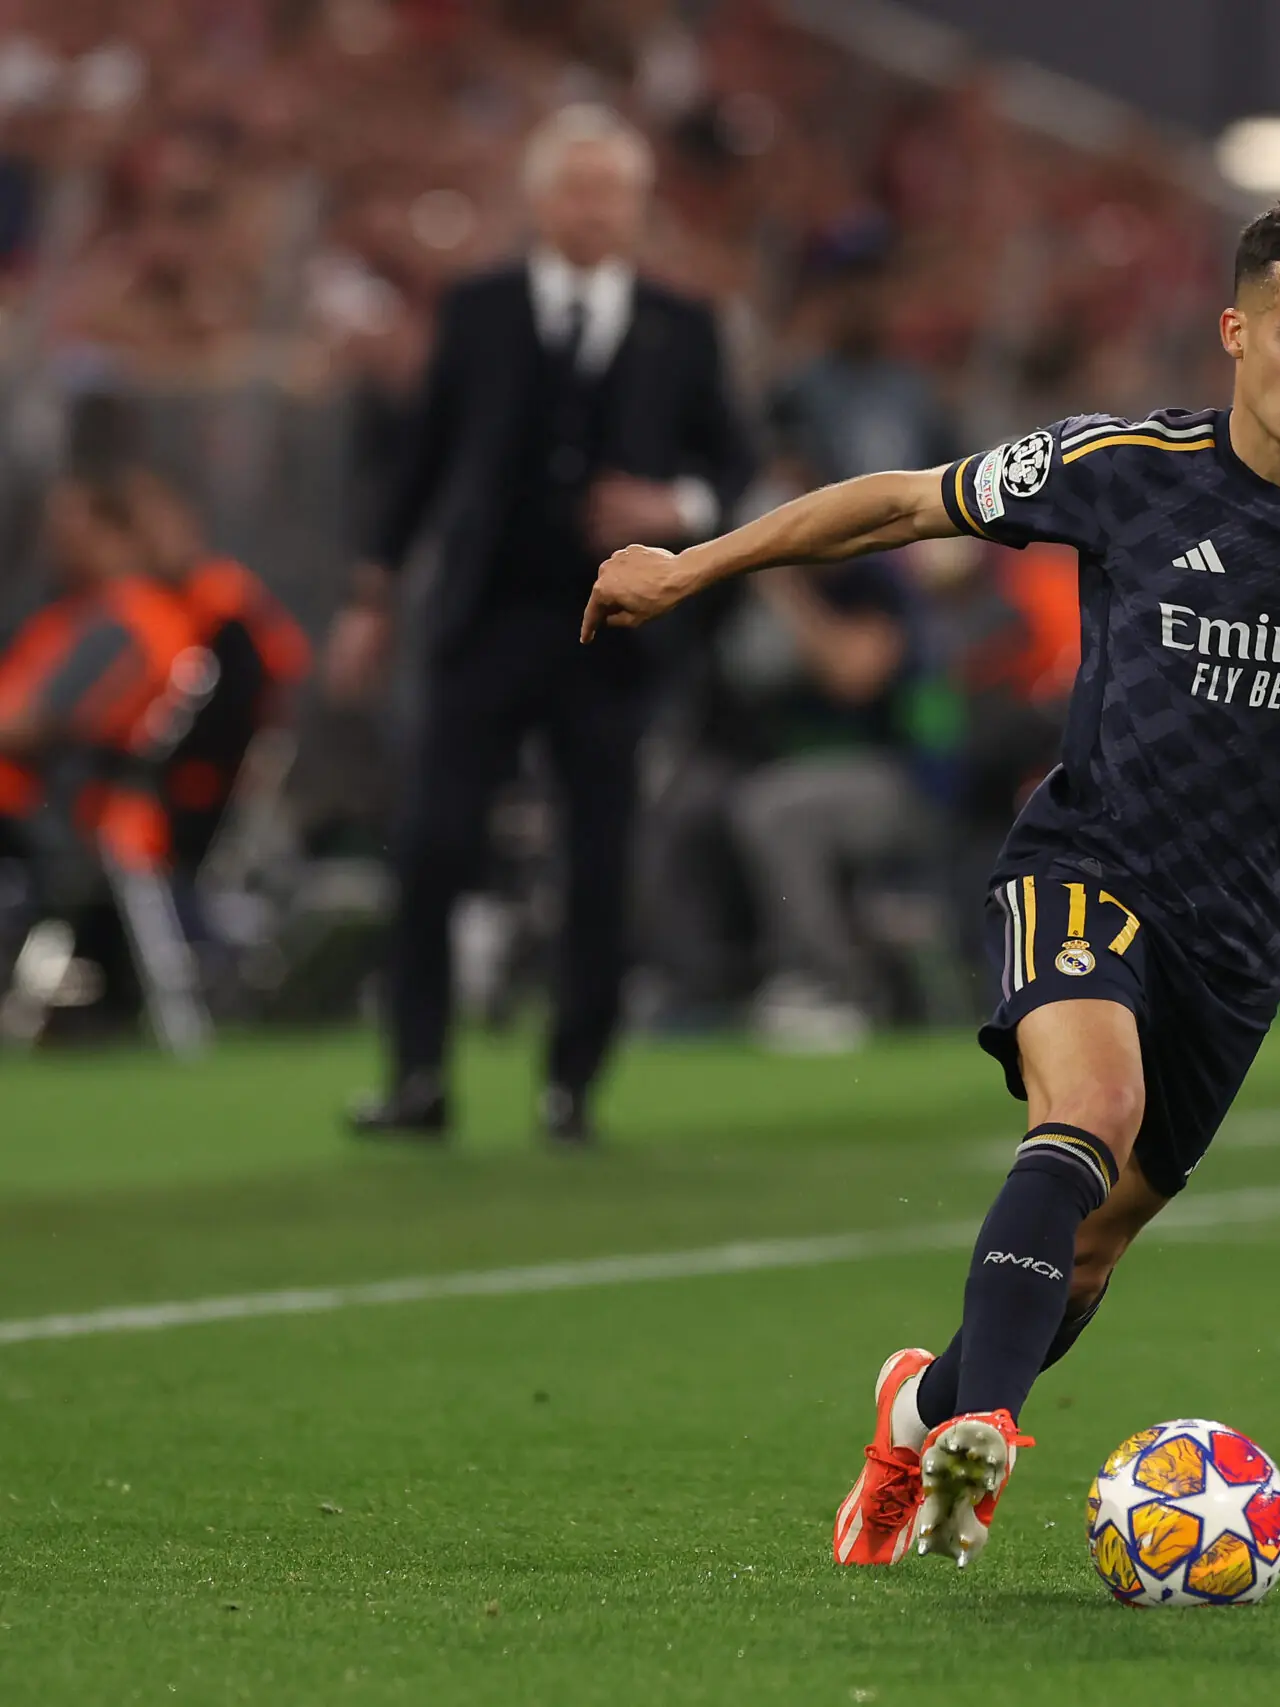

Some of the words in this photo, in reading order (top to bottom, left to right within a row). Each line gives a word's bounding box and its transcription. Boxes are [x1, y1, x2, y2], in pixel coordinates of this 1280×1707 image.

[1190, 662, 1244, 704] FLY
[1060, 882, 1141, 956] 17
[983, 1251, 1063, 1281] RMCF
